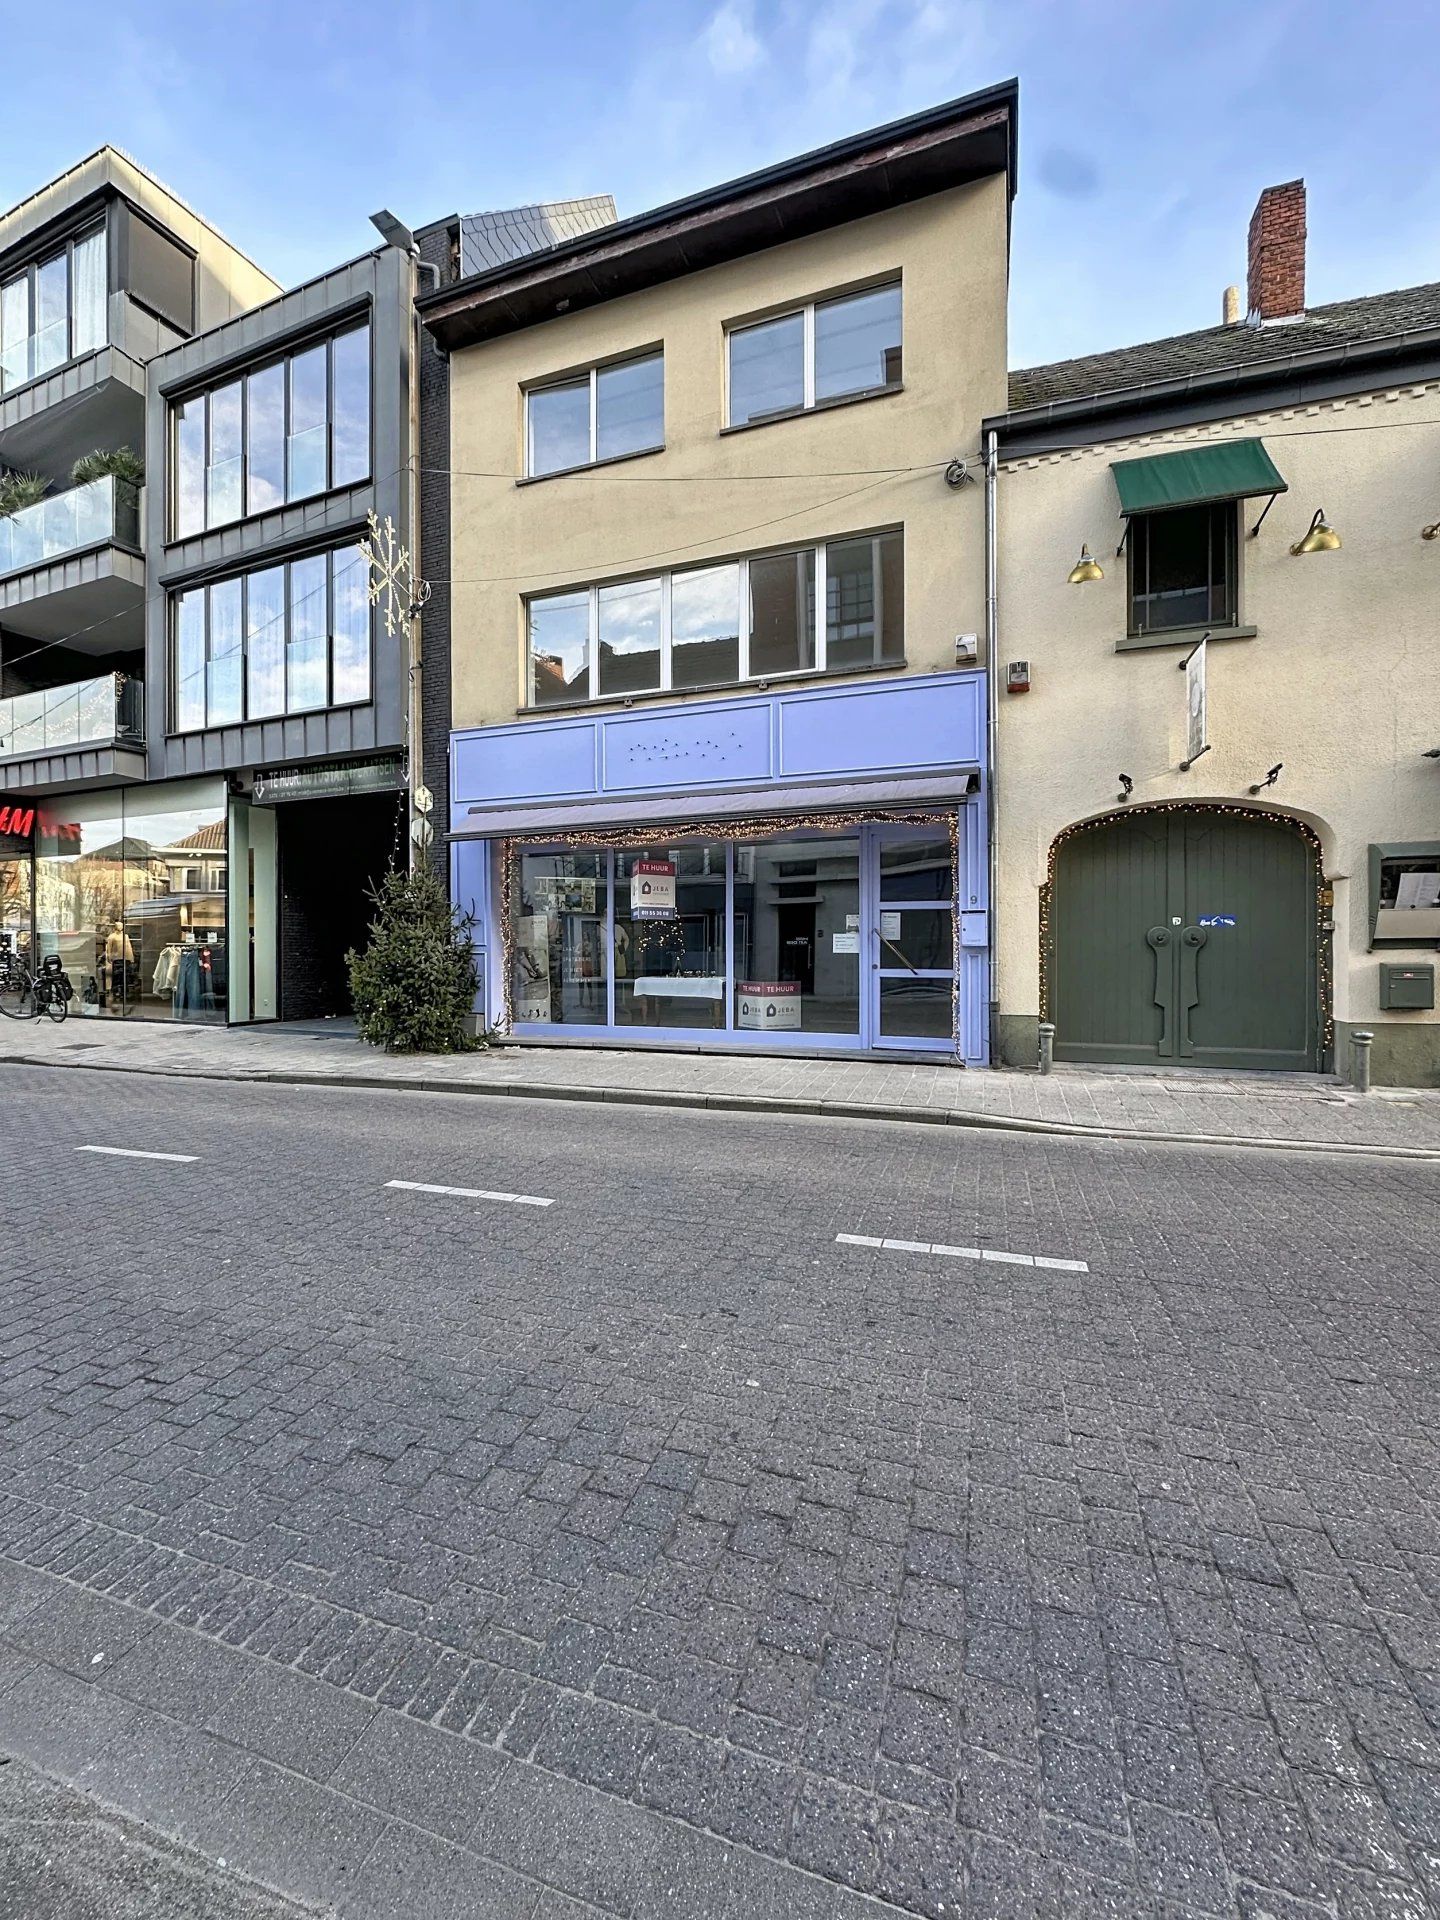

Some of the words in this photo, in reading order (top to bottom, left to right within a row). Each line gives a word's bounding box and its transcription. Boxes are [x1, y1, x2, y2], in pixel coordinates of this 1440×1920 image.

[269, 772, 278, 789] TE
[651, 864, 669, 872] HUUR
[970, 895, 978, 905] 9
